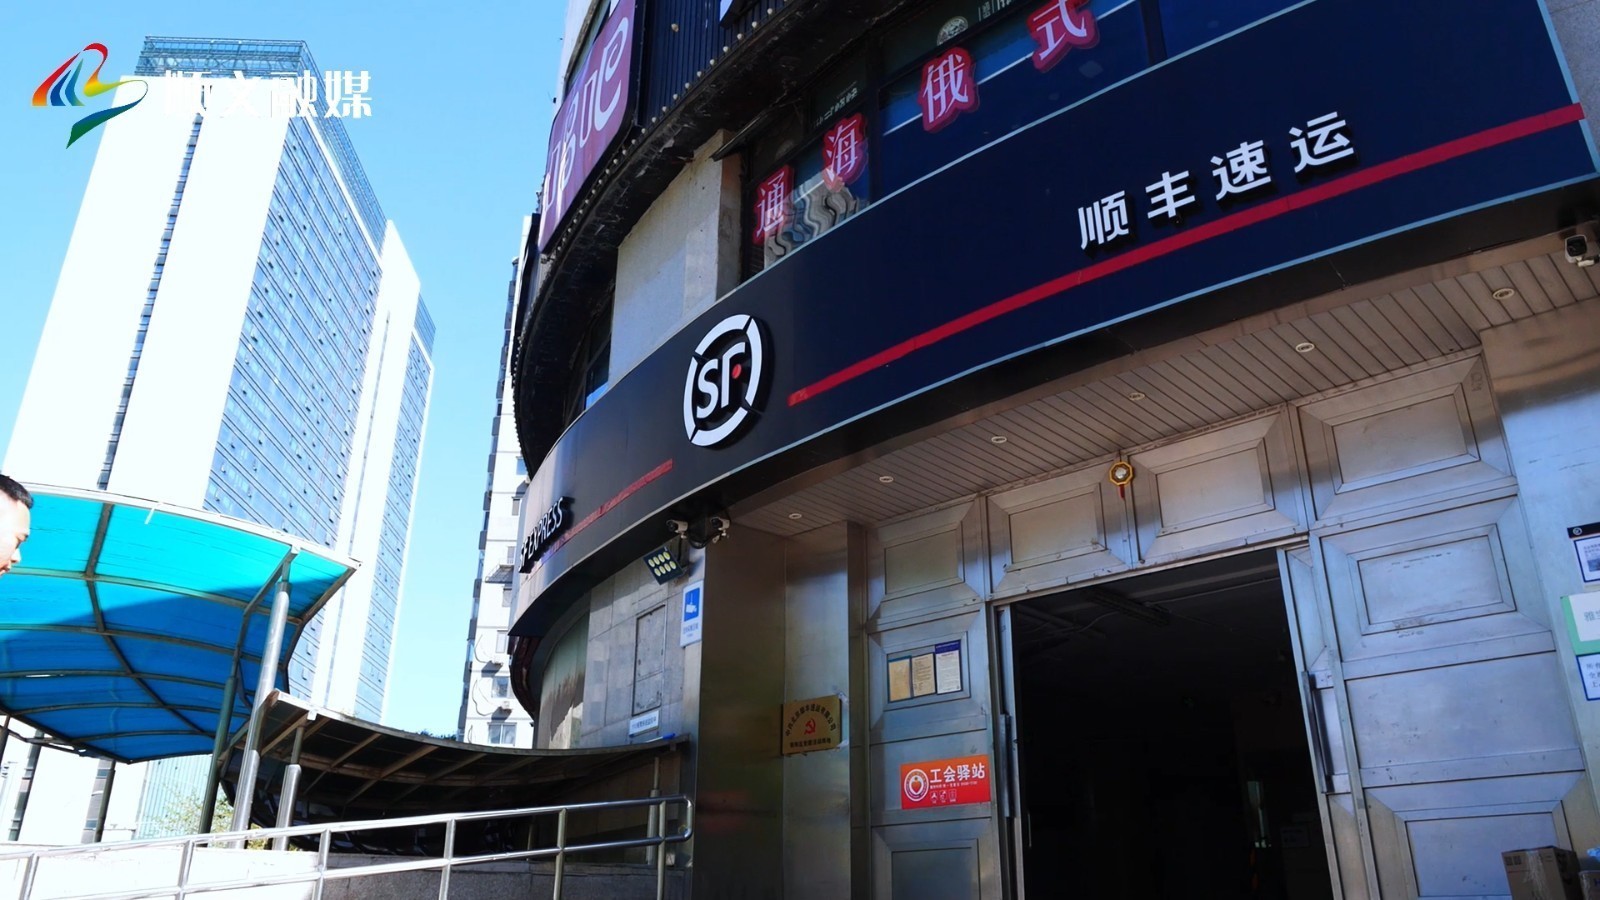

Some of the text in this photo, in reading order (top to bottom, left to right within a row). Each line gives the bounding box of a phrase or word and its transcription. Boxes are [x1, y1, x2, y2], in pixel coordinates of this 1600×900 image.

[1077, 111, 1355, 250] 顺丰速运
[527, 496, 564, 559] EXPRESS
[929, 762, 986, 784] 工会驿站
